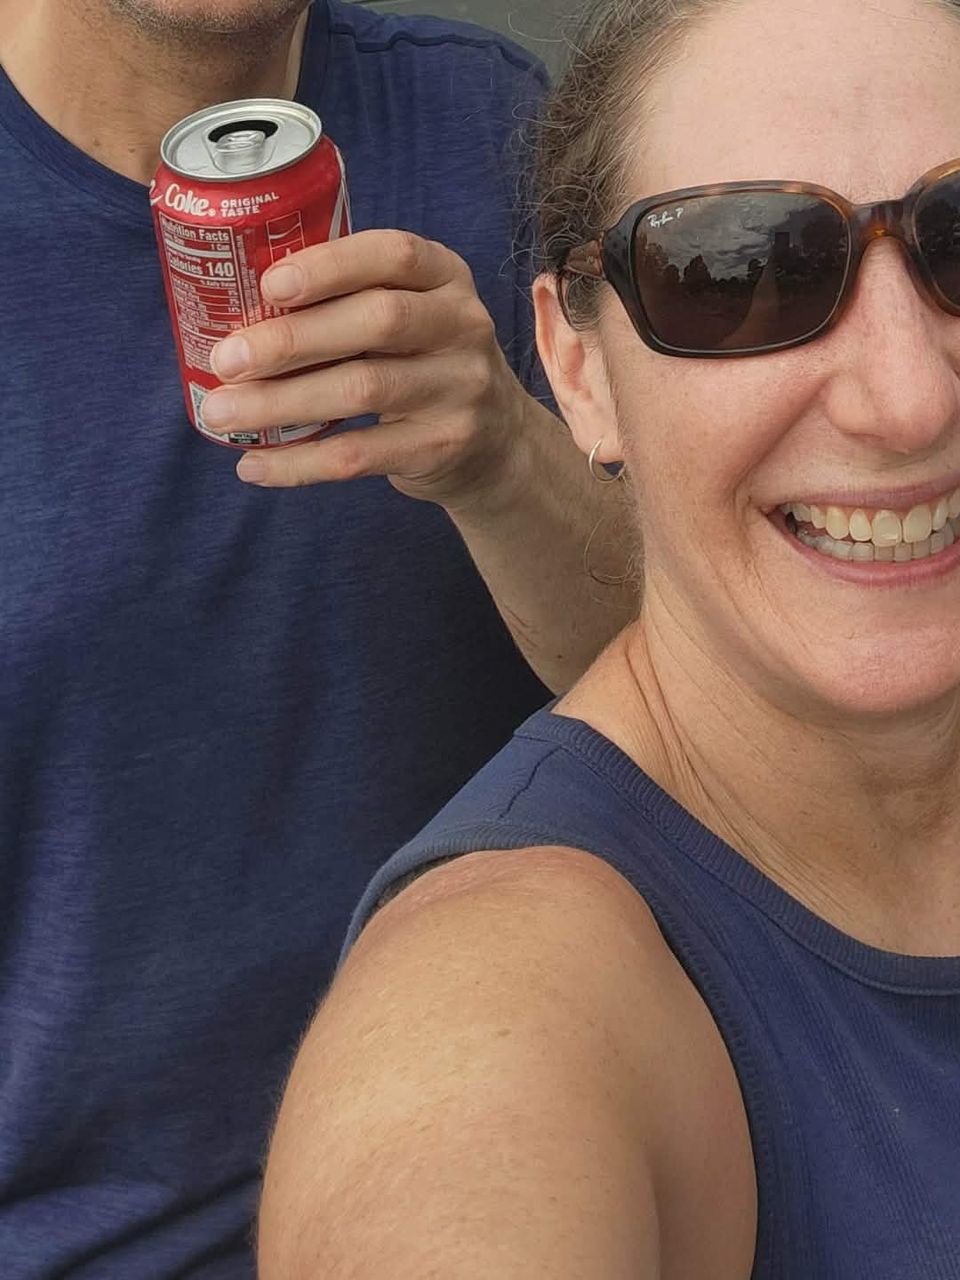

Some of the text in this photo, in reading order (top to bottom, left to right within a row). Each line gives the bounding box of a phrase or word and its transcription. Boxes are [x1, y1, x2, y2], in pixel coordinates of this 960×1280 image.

[164, 183, 209, 217] Coke
[221, 191, 279, 208] ORIGINAL
[221, 204, 260, 218] TASTE
[199, 228, 230, 241] Facts
[168, 253, 203, 275] Calories
[205, 261, 235, 277] 140
